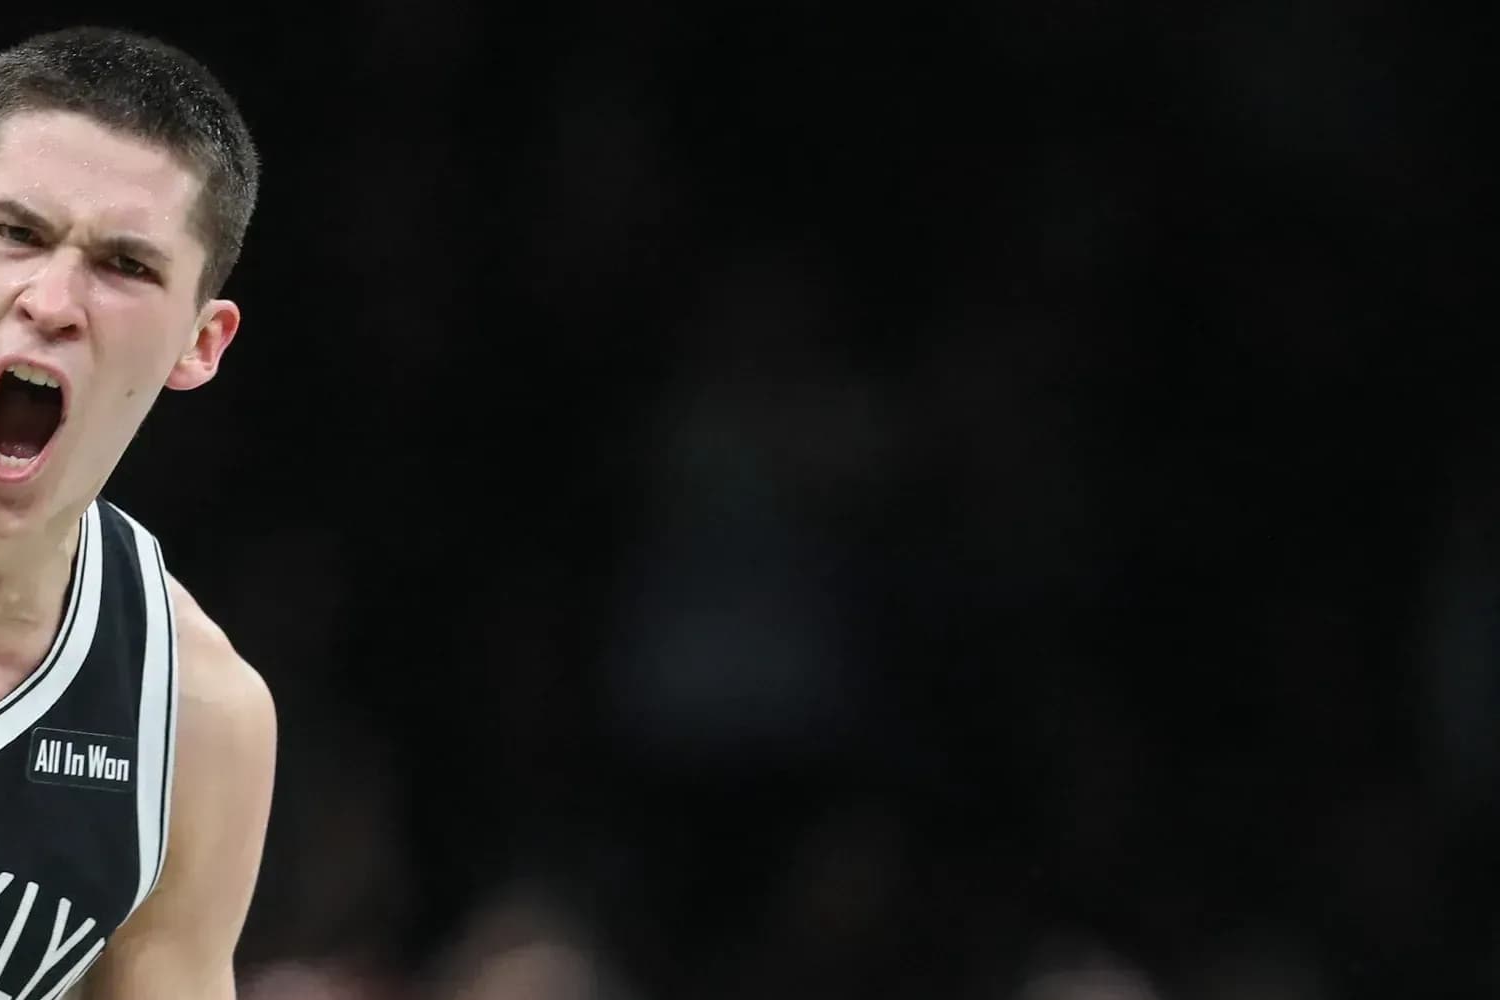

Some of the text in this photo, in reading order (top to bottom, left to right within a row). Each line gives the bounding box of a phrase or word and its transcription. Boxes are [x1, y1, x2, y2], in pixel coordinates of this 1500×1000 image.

[34, 739, 130, 781] All In Won
